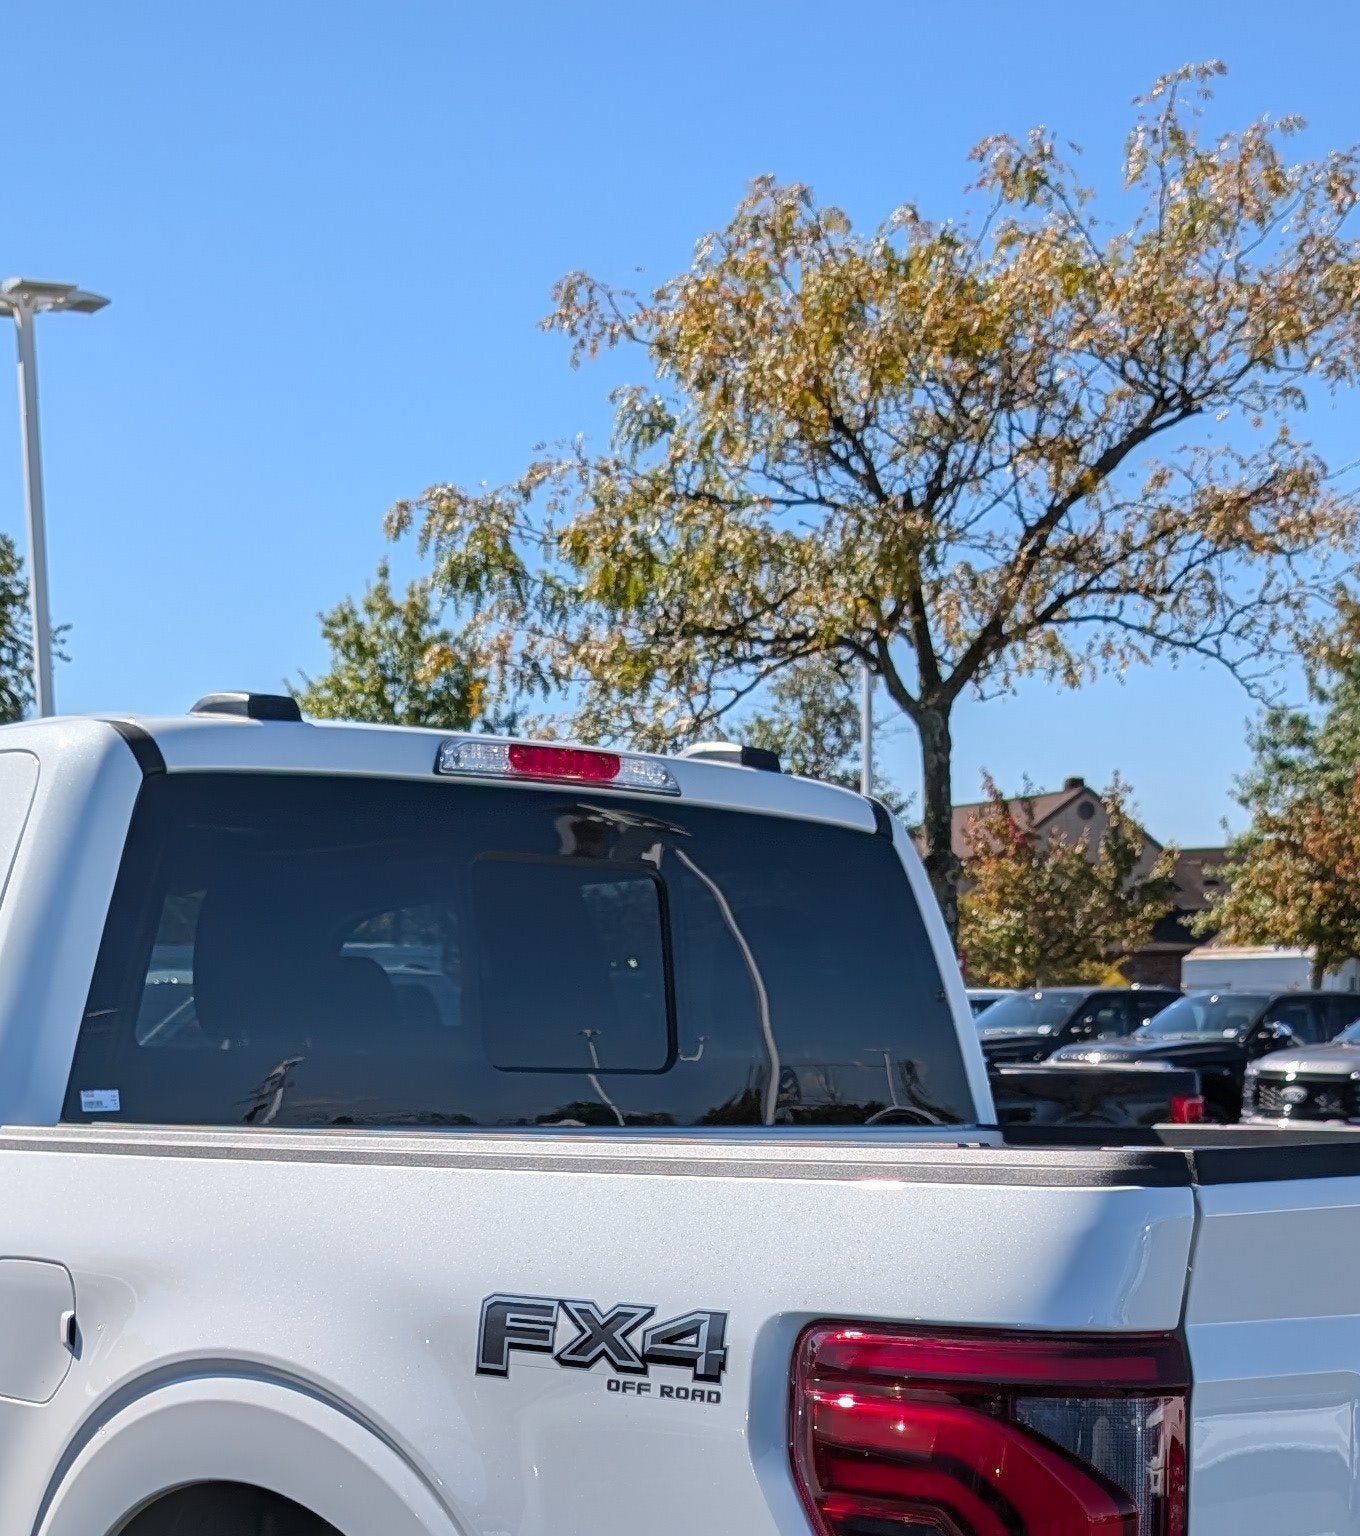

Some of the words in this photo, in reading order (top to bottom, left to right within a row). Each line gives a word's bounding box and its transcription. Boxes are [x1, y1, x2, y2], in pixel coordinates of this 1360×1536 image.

[476, 1292, 730, 1385] FX4
[606, 1378, 651, 1396] OFF
[659, 1384, 722, 1404] ROAD
